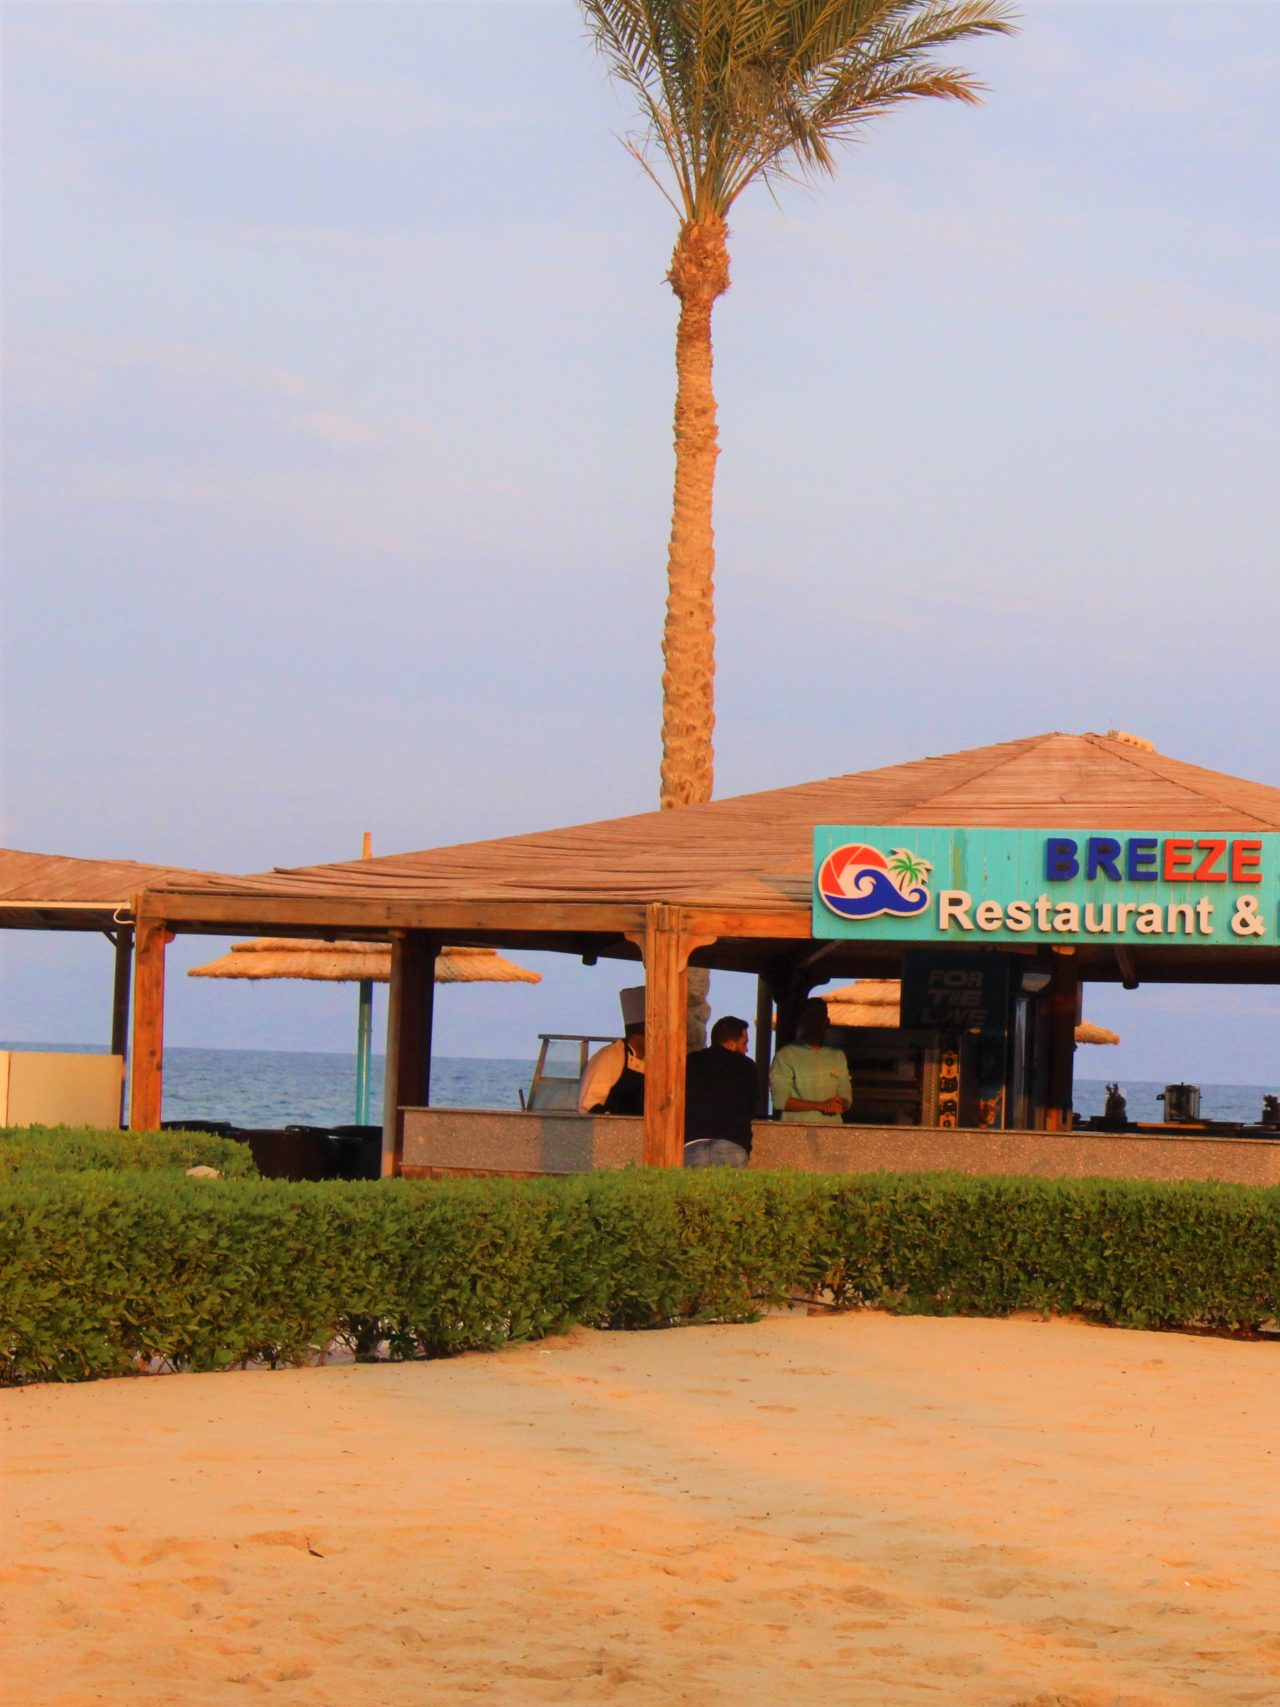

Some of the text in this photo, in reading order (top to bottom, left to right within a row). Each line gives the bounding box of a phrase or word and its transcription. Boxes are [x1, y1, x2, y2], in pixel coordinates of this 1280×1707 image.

[1045, 837, 1264, 883] BREEZE
[938, 889, 1214, 934] Restaurant
[1230, 895, 1267, 936] &
[928, 969, 983, 988] FOR
